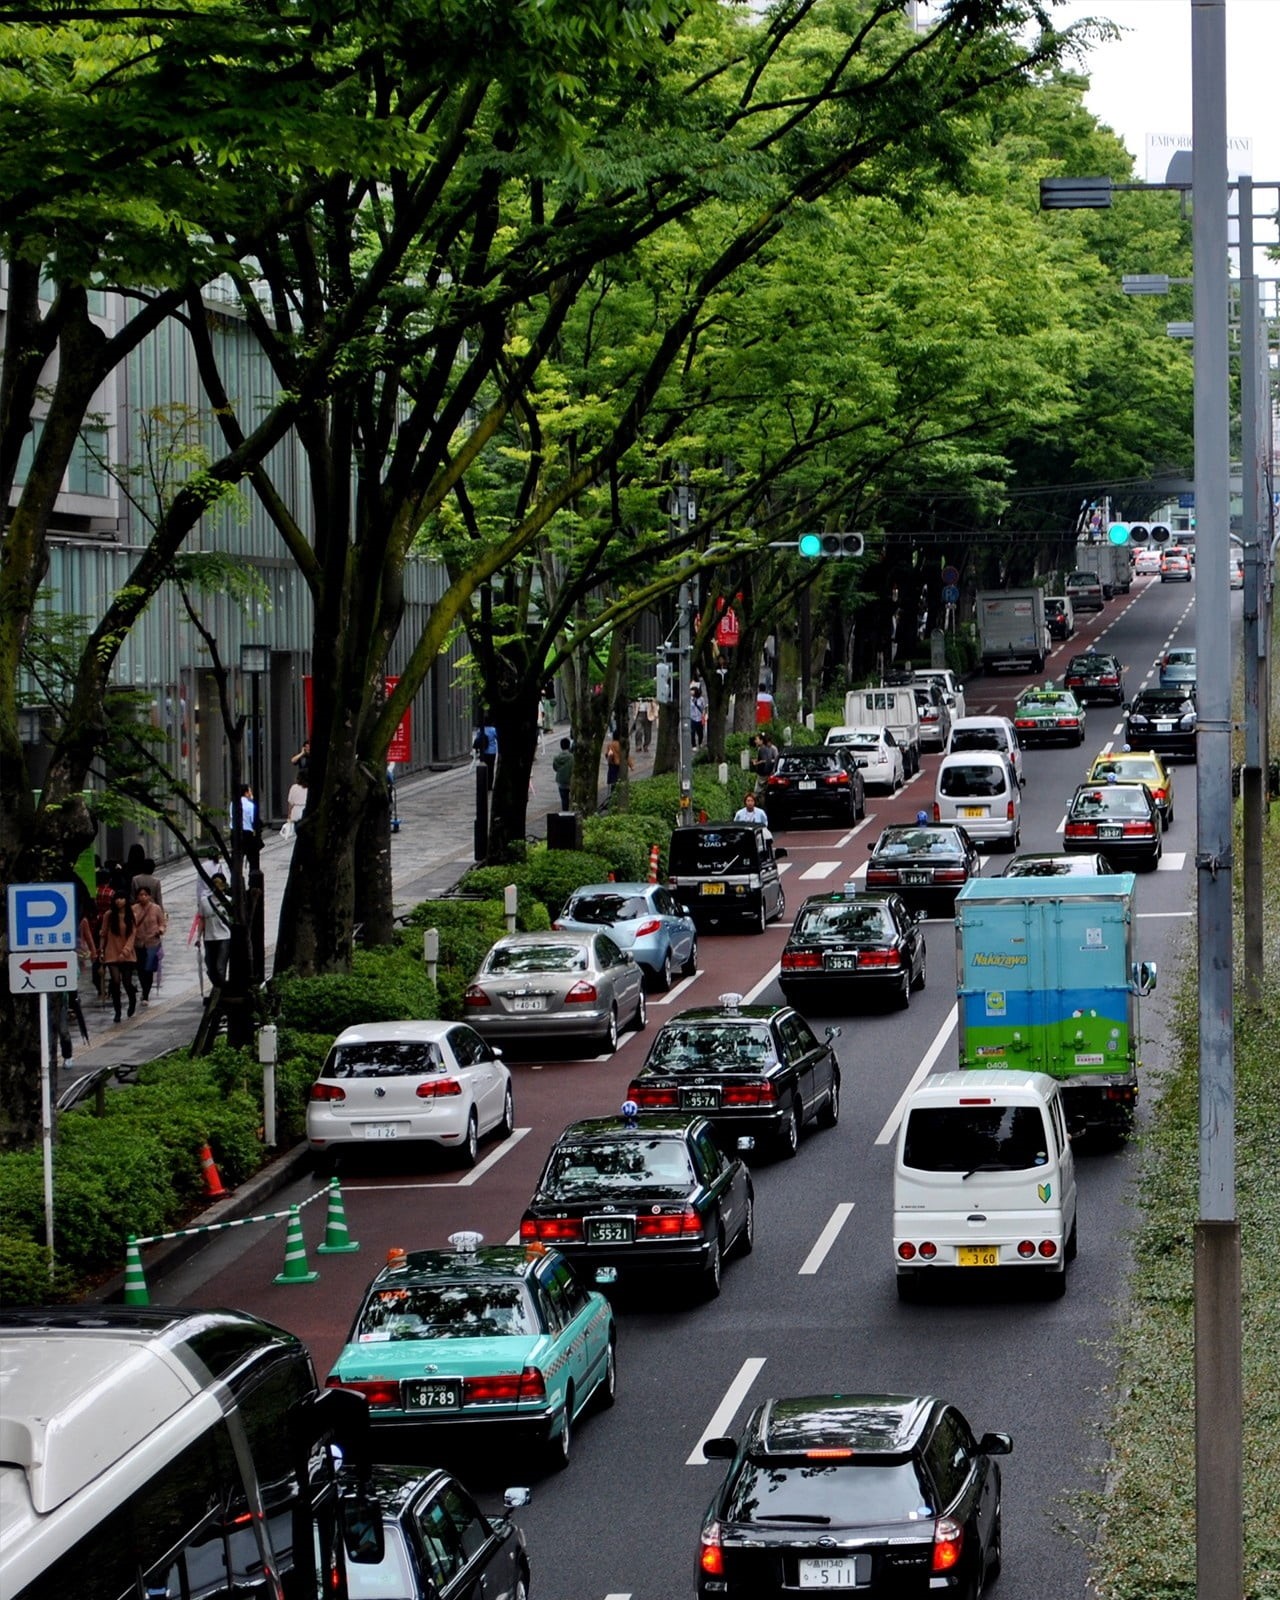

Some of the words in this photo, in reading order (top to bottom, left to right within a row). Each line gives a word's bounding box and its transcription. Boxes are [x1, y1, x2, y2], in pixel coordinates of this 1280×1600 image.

[1227, 139, 1249, 151] MANI
[15, 889, 68, 946] P
[34, 931, 72, 945] 駐車場
[971, 952, 1029, 968] Nakazawa
[21, 975, 68, 990] 入口
[599, 1228, 628, 1241] 55-21
[419, 1391, 455, 1406] 87-89
